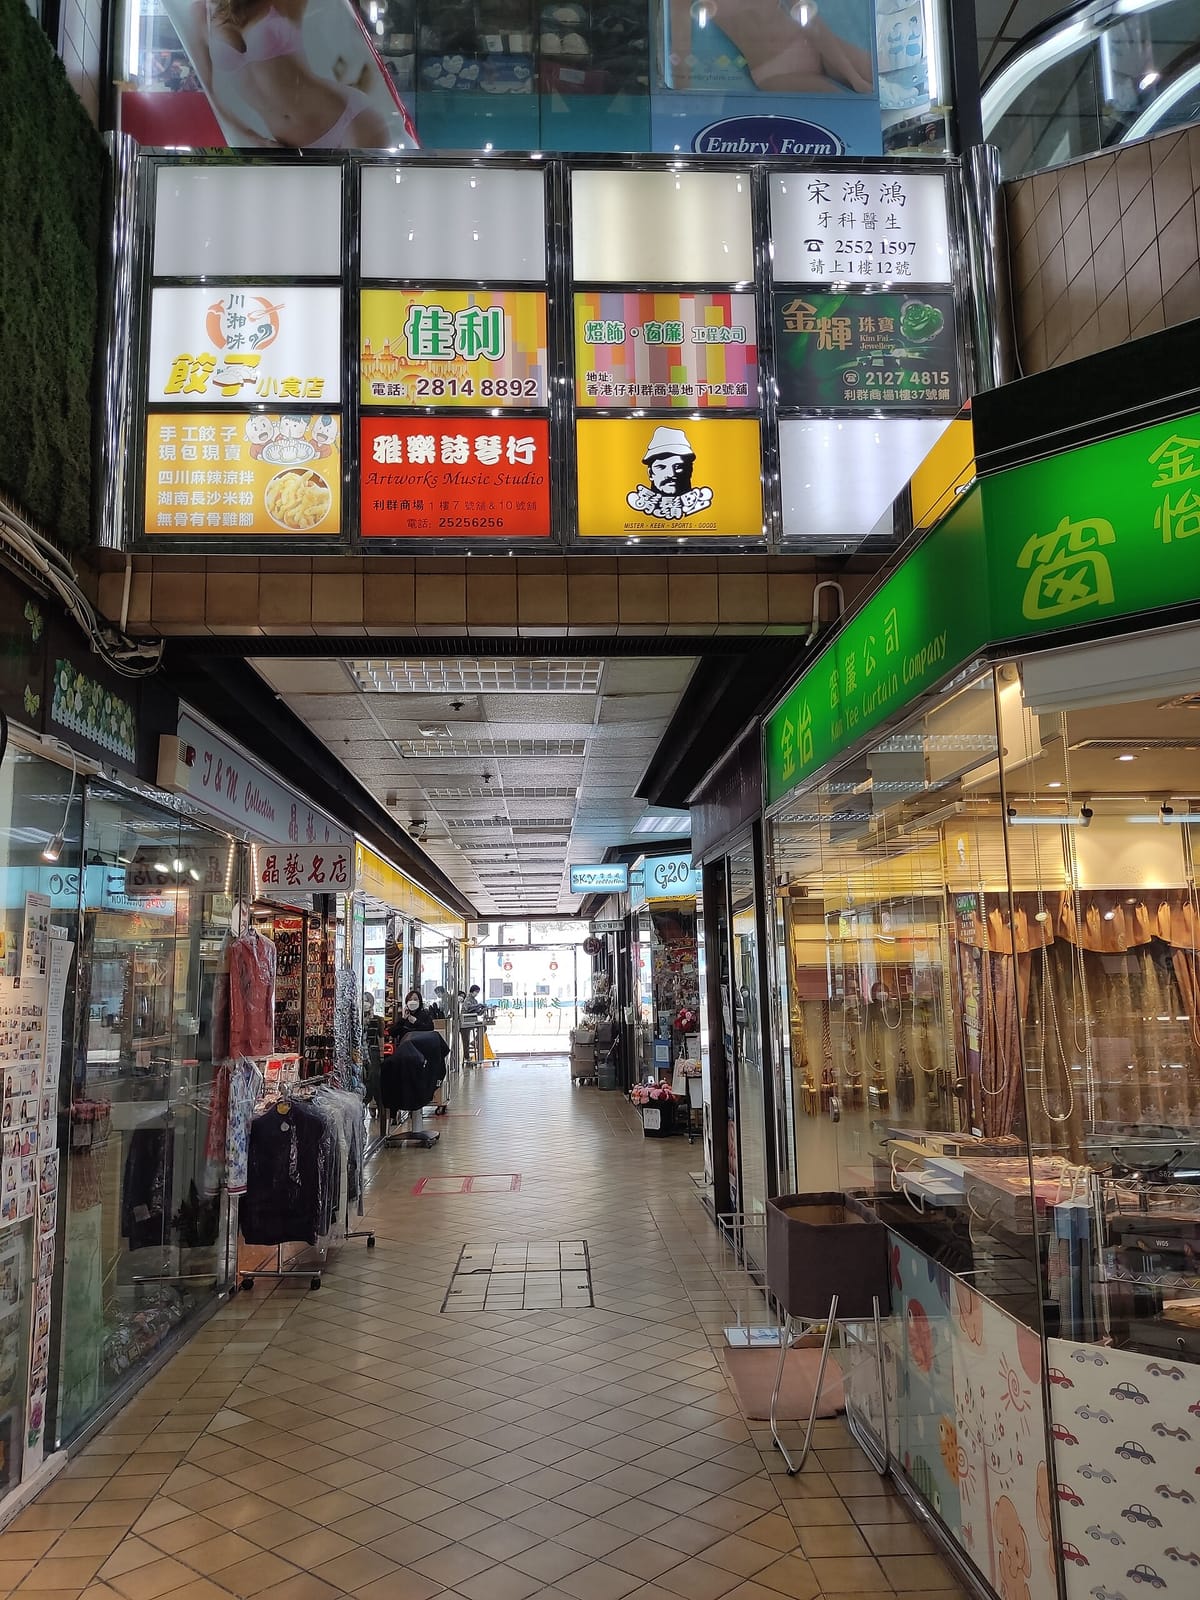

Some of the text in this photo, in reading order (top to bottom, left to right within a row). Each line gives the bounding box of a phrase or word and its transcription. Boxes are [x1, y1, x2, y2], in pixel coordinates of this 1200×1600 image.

[706, 137, 831, 154] Embry Form
[808, 180, 906, 206] 宋鴻鴻
[817, 212, 902, 231] 牙科醫生
[835, 240, 916, 255] 2552 1597
[810, 259, 912, 276] 請上1樓12號
[226, 294, 246, 350] 川湘味
[782, 299, 896, 350] 金輝 珠寶
[404, 305, 505, 361] 佳利
[691, 326, 747, 343] 工程公司
[860, 342, 896, 351] Jewellery
[865, 372, 950, 385] 2127 4815
[416, 379, 474, 397] 2814
[480, 380, 537, 397] 8892
[159, 426, 238, 442] 手工餃子
[159, 444, 241, 461] 現包現賣
[372, 434, 537, 465] 雅樂詩琴行
[158, 470, 255, 485] 四川麻辣涼拌
[365, 471, 544, 488] Artworks Music Studio
[157, 491, 254, 506] 湖南長沙米粉
[156, 512, 254, 527] 無骨有骨雞腳
[439, 517, 504, 528] 25256256
[845, 705, 859, 730] Yee
[862, 670, 899, 717] Curtain
[903, 628, 947, 685] Company
[781, 697, 814, 782] 金怡
[215, 758, 222, 792] &
[226, 766, 239, 804] M
[244, 782, 276, 822] Collection
[262, 852, 347, 885] 晶藝名店
[655, 861, 689, 889] G20
